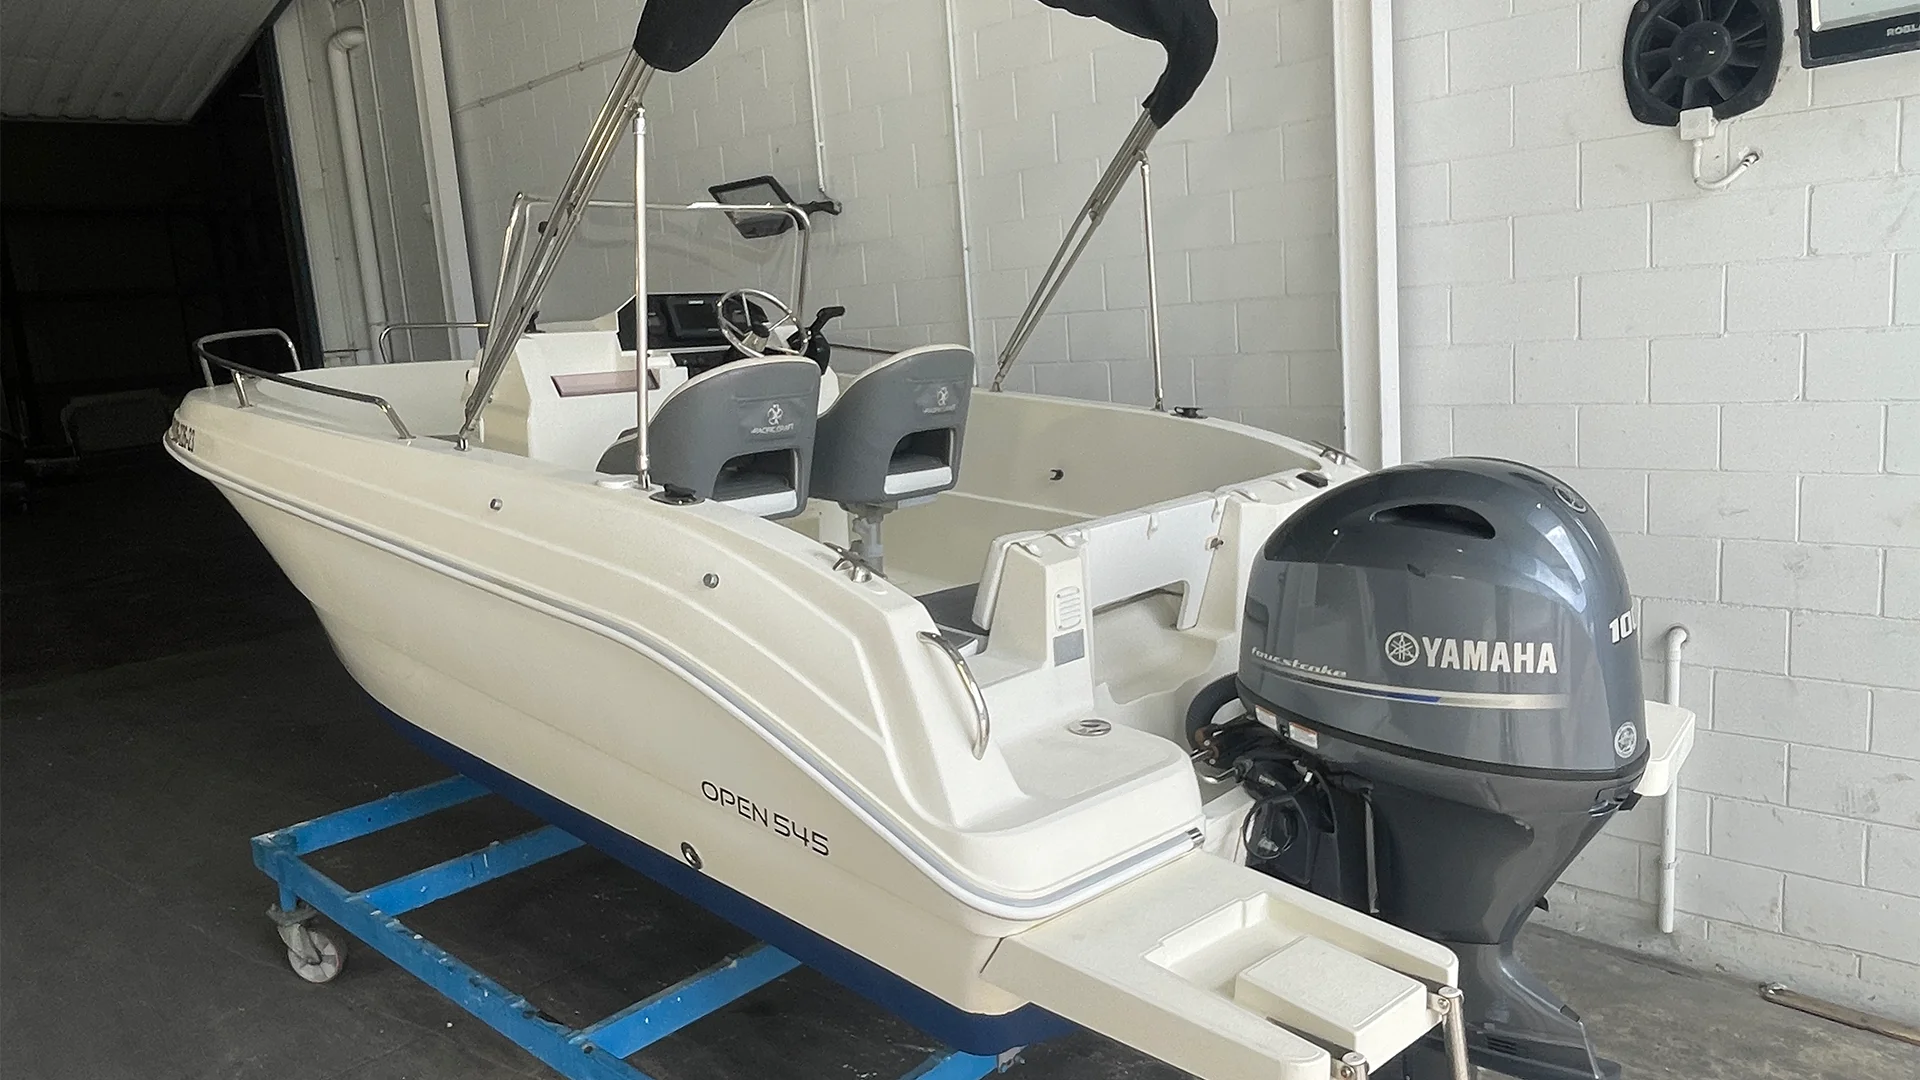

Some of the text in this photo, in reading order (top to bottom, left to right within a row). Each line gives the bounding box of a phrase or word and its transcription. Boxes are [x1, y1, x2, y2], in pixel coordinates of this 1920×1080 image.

[1421, 636, 1558, 674] YAMAHA
[701, 780, 830, 856] OPEN 545
